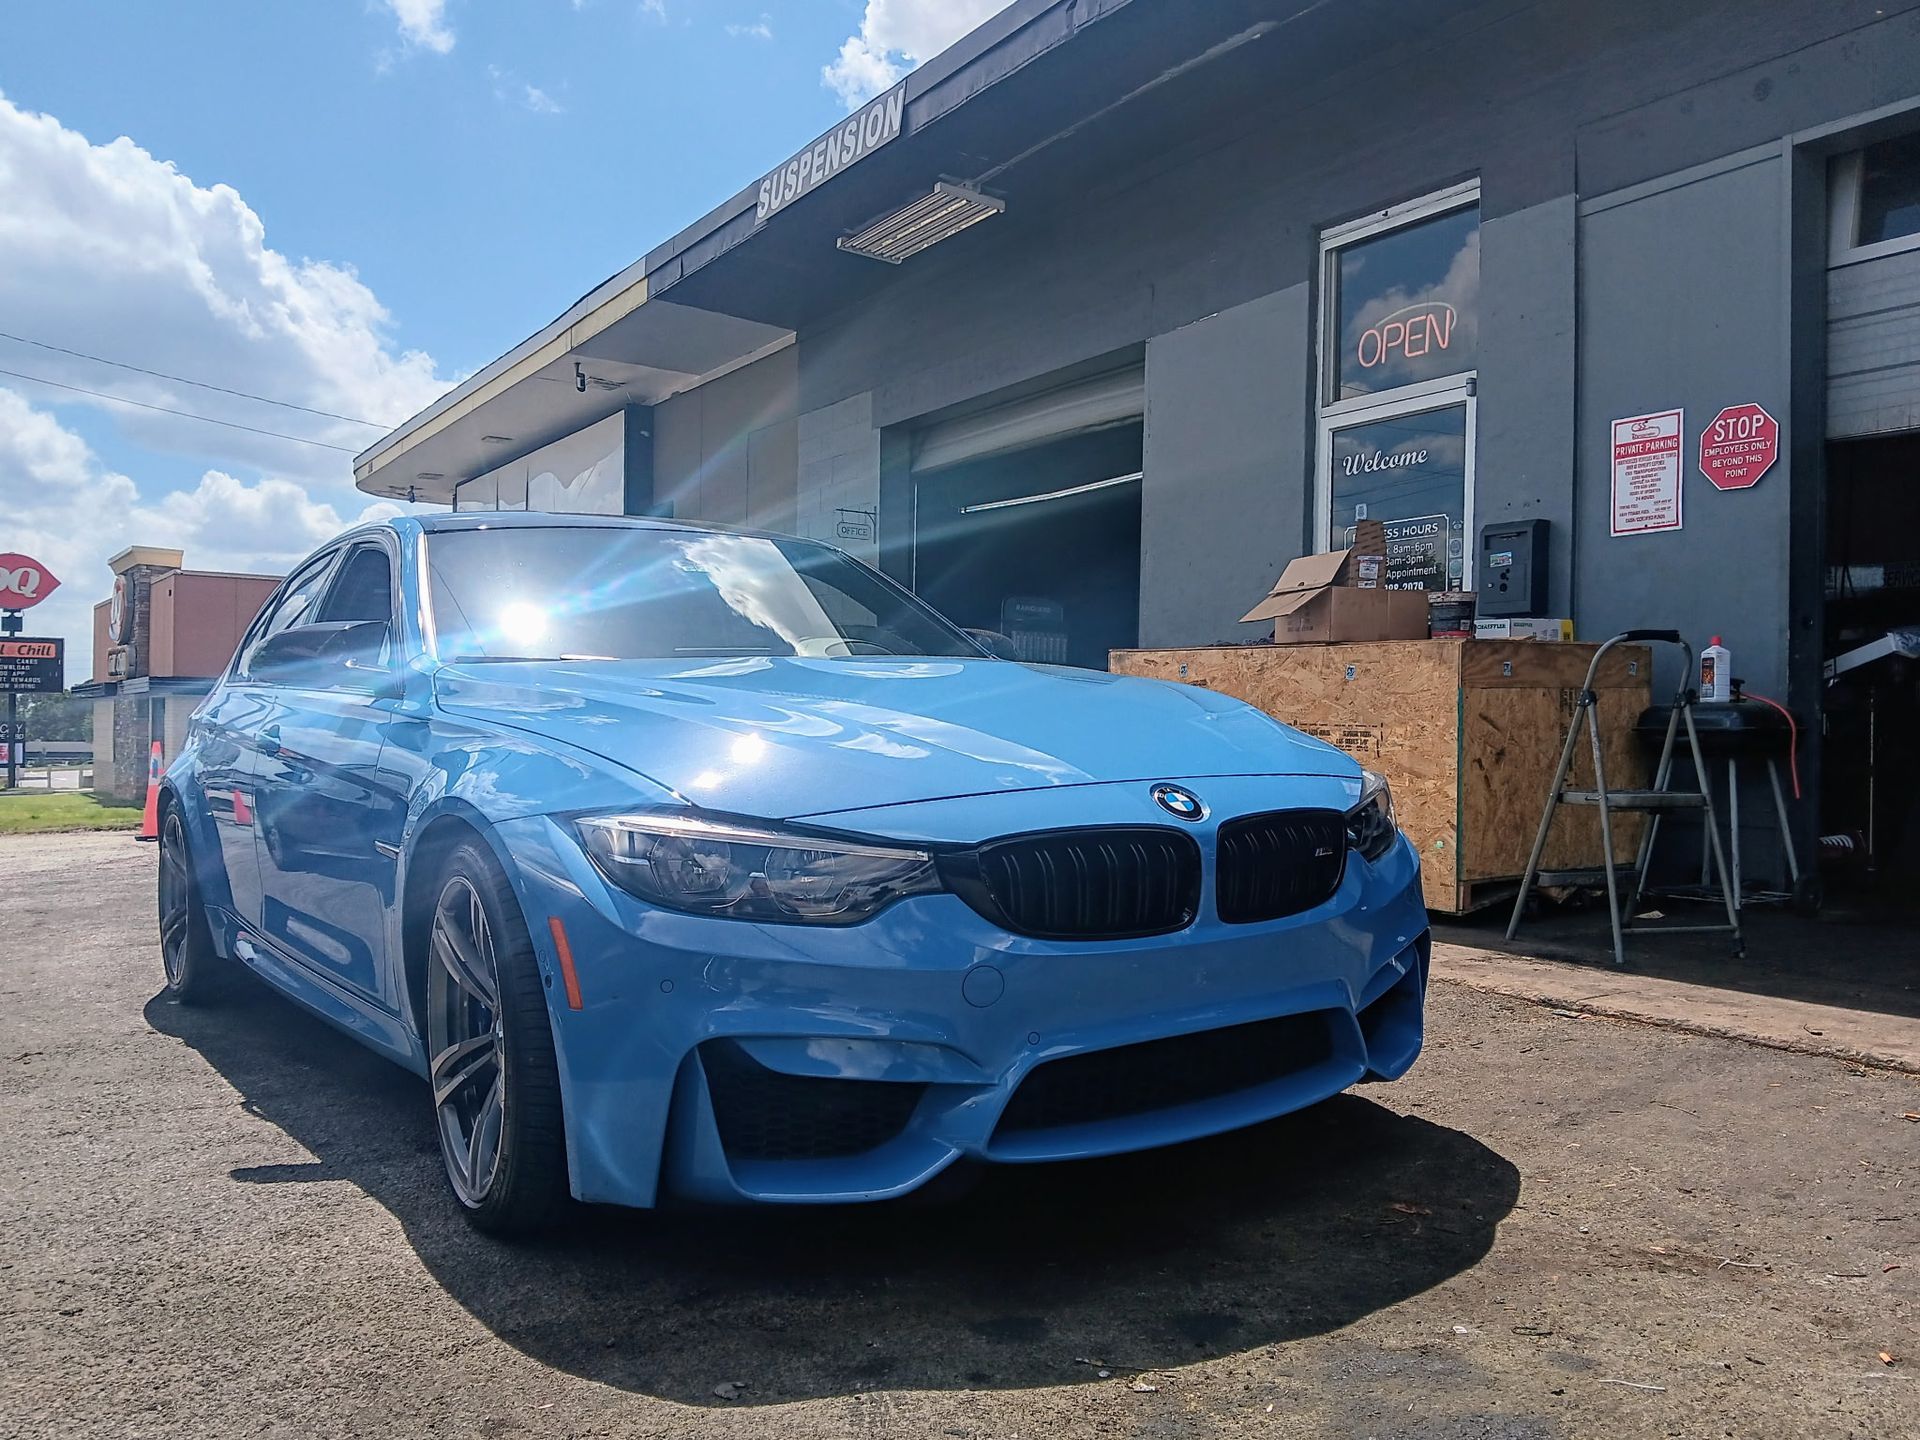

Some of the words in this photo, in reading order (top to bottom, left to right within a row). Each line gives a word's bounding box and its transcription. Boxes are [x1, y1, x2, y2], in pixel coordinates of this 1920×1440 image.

[757, 88, 904, 218] SUSPENSION
[1358, 309, 1451, 368] OPEN
[1713, 414, 1765, 442] STOP
[1615, 443, 1644, 457] PRIVATE
[1645, 437, 1678, 451] PARKING
[1704, 444, 1749, 457] EMPLOYEES
[1751, 440, 1772, 450] ONLY
[1342, 449, 1429, 476] Welcome
[1712, 457, 1743, 468] BEYOND
[1745, 454, 1763, 463] THIS
[1725, 468, 1748, 478] POINT
[841, 526, 868, 537] OFFICE
[1402, 522, 1439, 537] HOURS
[1393, 541, 1433, 554] 8am-6pm
[1386, 566, 1437, 580] Appointment
[17, 644, 52, 656] Chill
